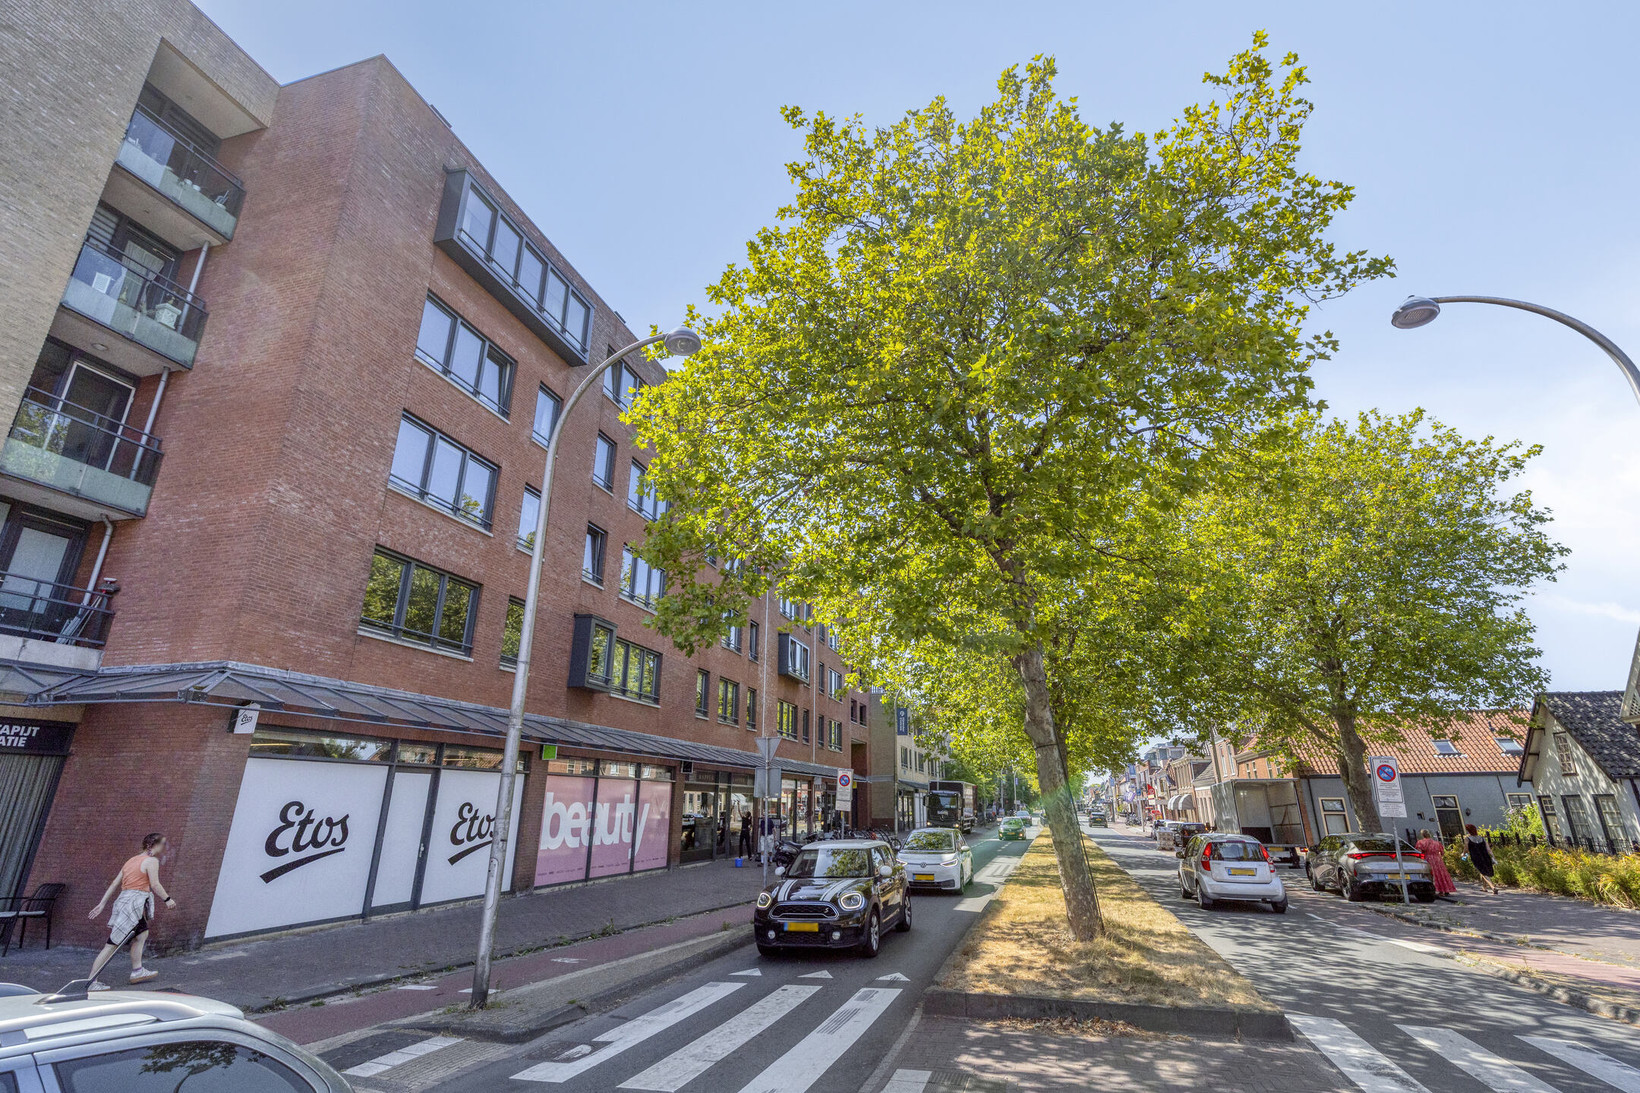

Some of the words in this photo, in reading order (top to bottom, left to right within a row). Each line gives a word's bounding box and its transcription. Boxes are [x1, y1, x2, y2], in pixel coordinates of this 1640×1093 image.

[265, 801, 349, 857] Etos
[450, 802, 496, 846] Eto
[540, 792, 650, 860] beauty
